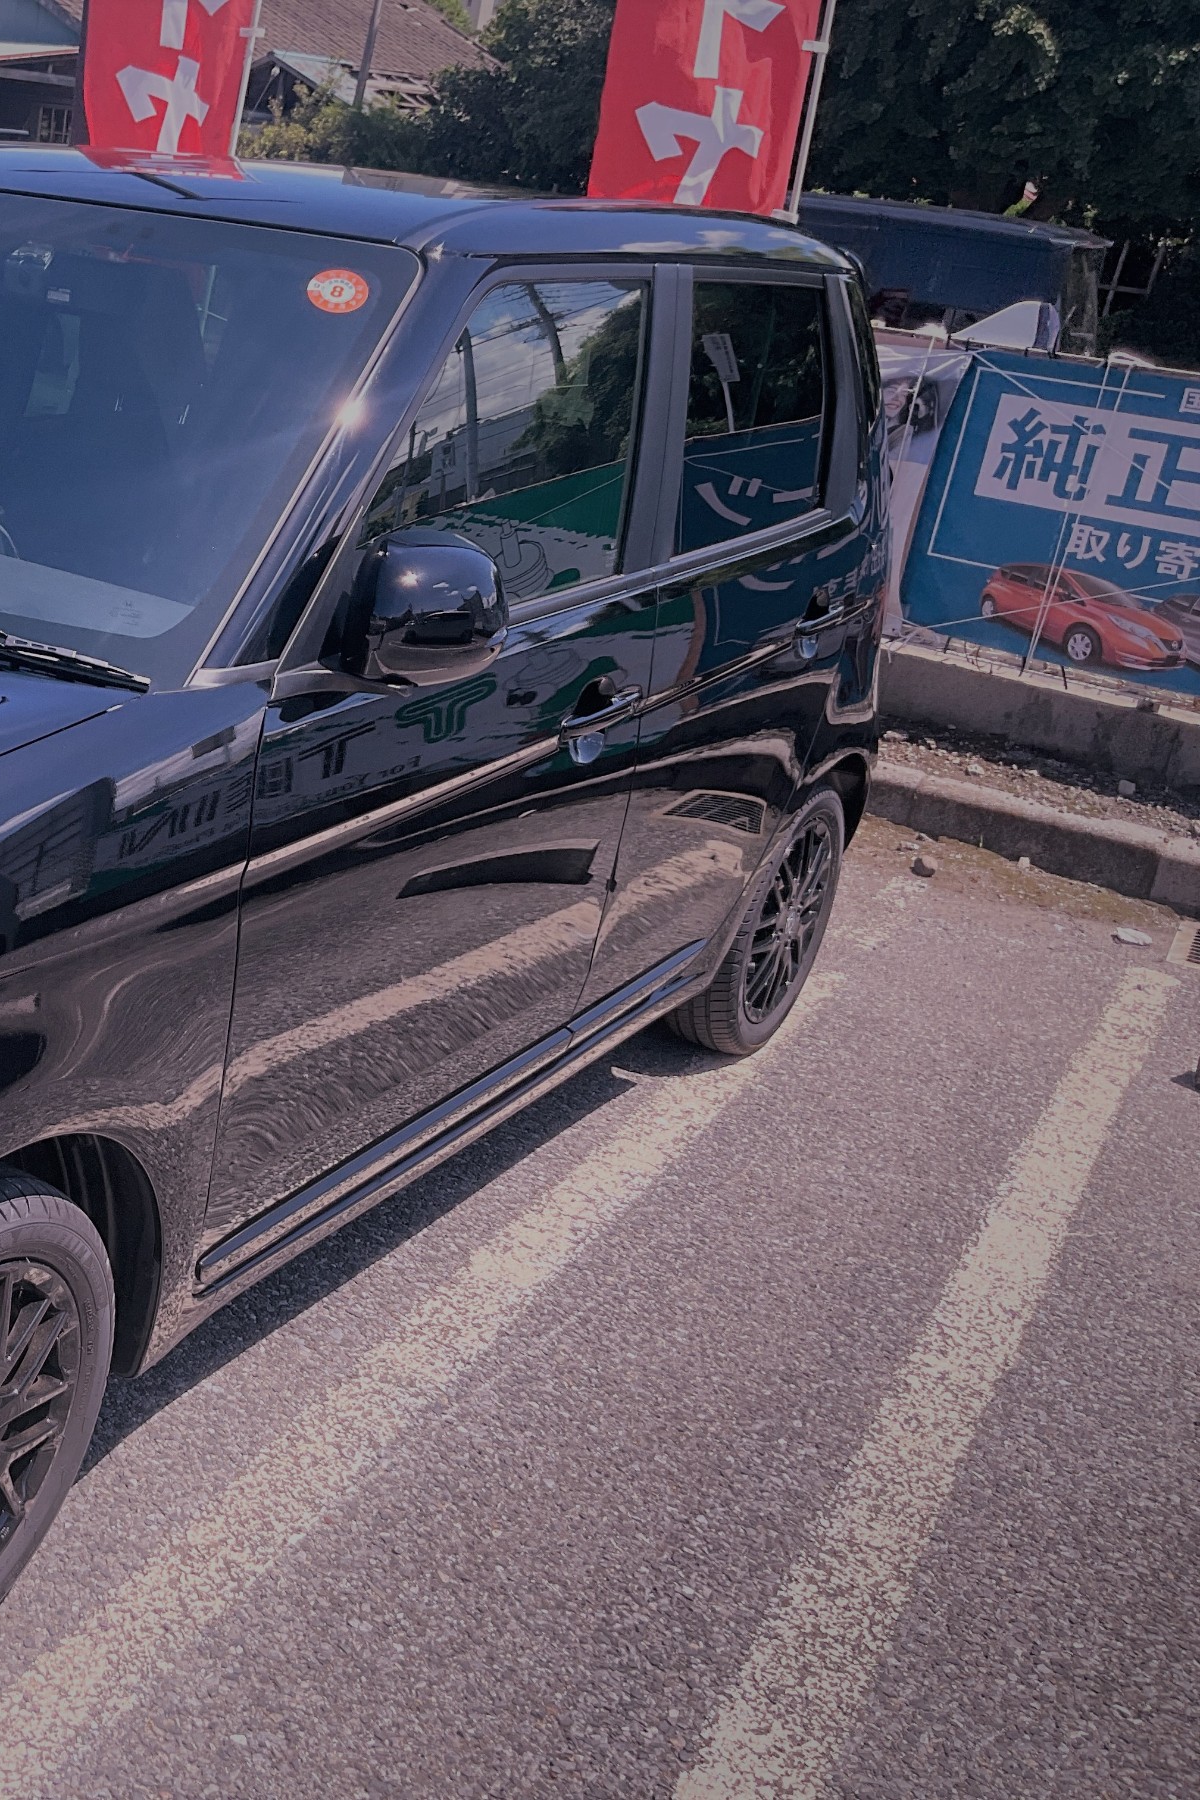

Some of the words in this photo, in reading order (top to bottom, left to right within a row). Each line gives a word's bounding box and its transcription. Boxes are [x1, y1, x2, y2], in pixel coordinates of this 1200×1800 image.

[330, 285, 345, 298] 8
[992, 407, 1200, 521] 純正
[1065, 523, 1200, 580] 取り寄
